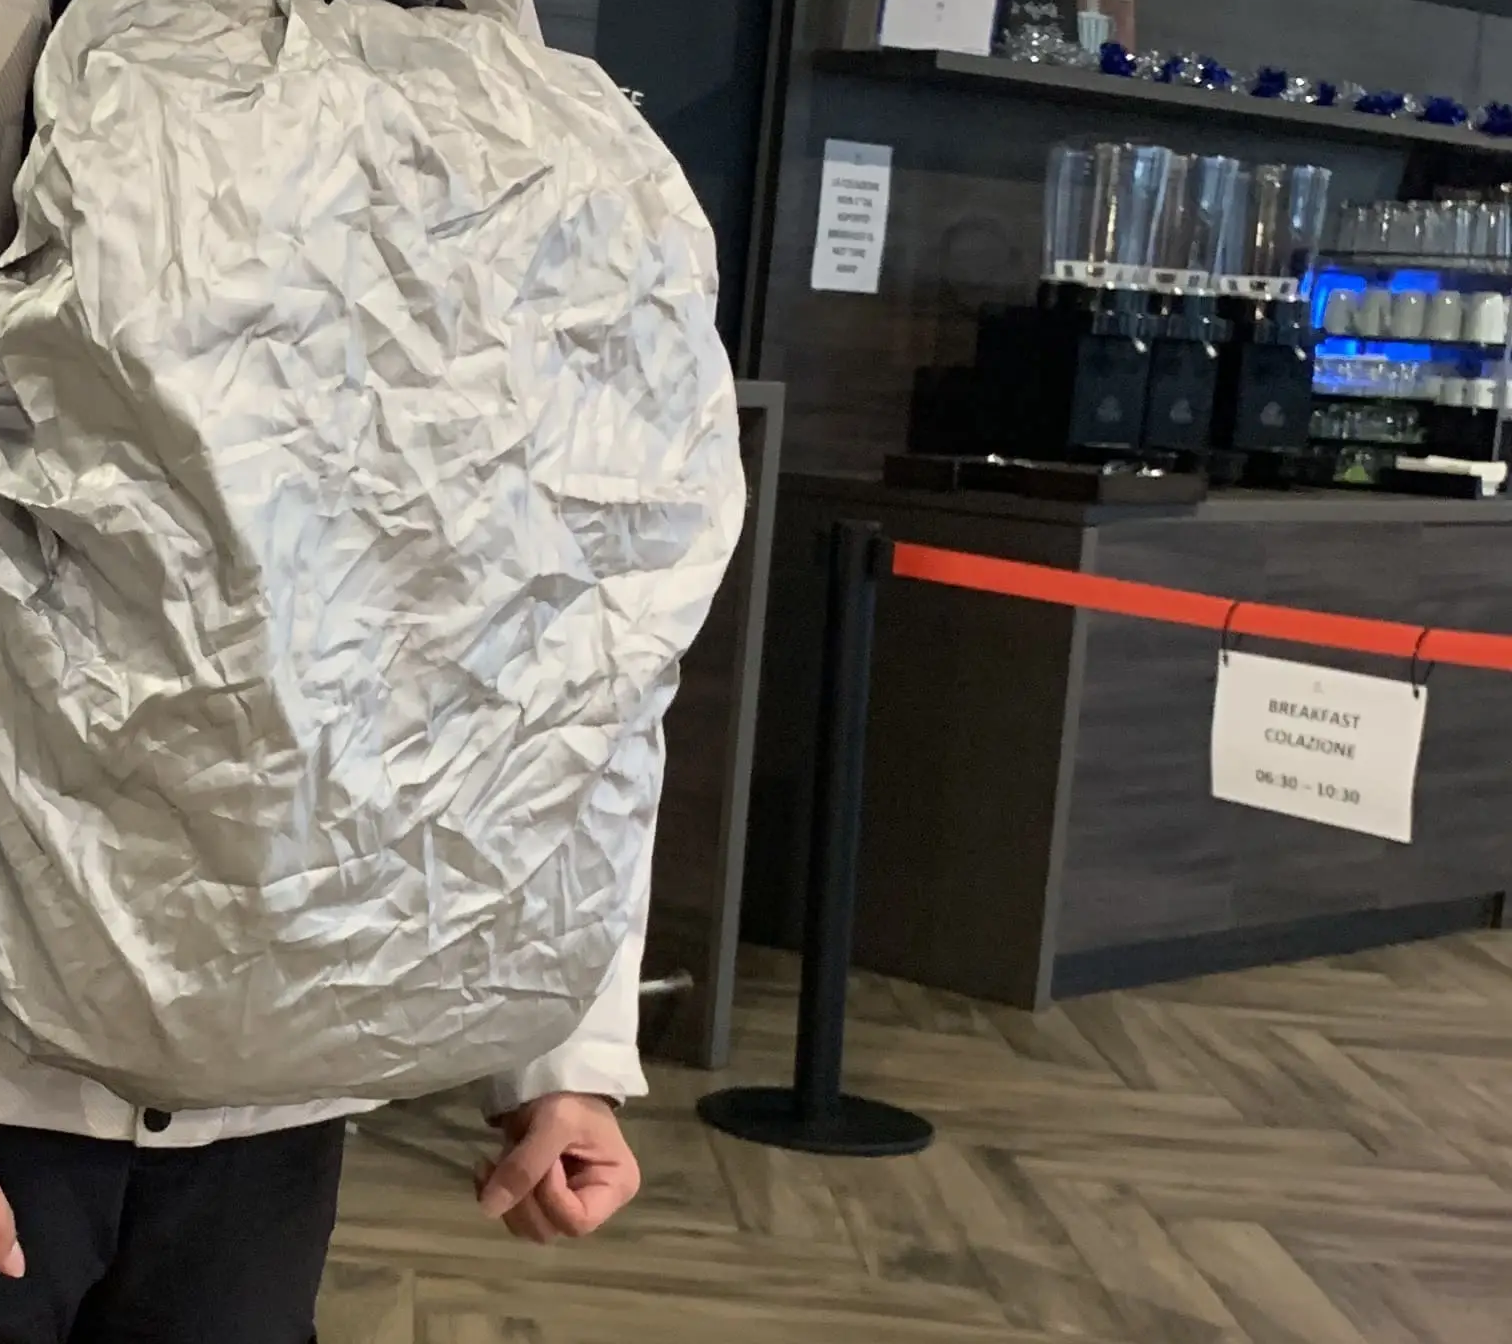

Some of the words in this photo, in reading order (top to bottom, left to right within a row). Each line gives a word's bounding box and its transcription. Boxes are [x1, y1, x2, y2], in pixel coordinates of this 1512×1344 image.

[1268, 698, 1360, 728] BREAKFAST
[1264, 728, 1355, 759] COLAZIONE
[1255, 768, 1298, 790] 06:30
[1317, 781, 1361, 805] 10:30
